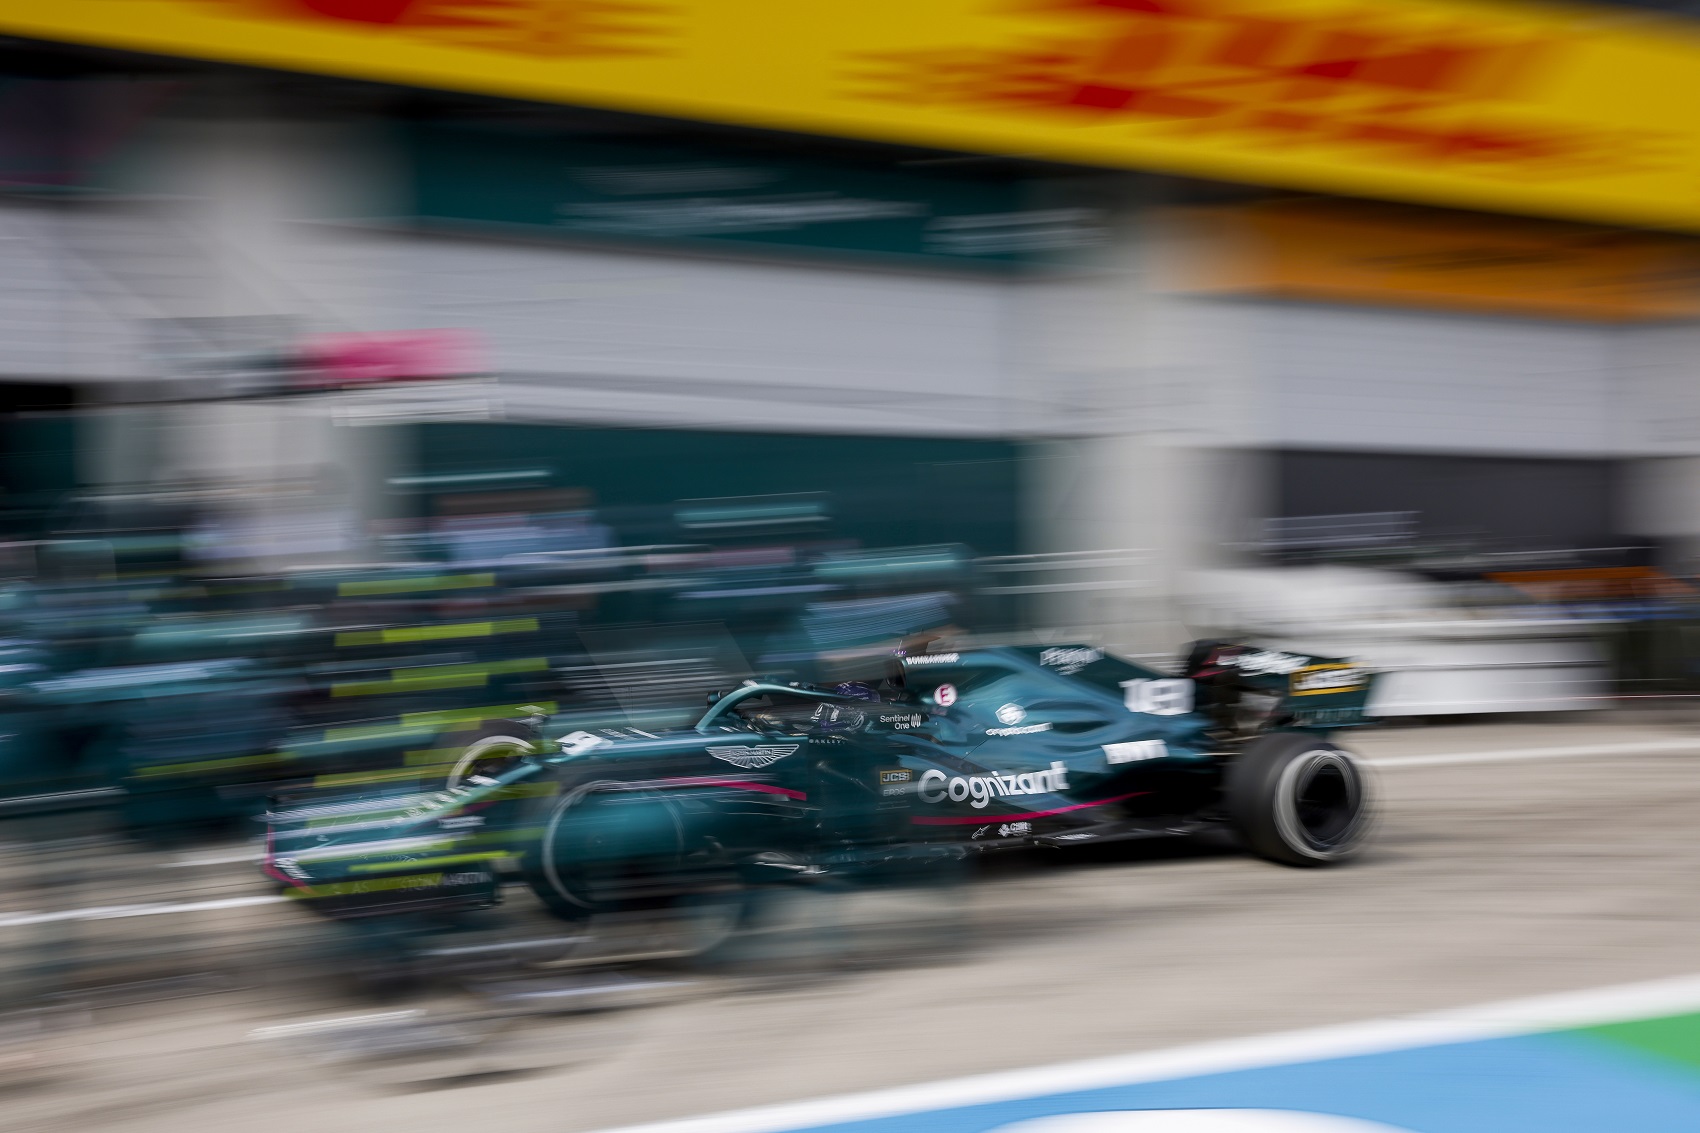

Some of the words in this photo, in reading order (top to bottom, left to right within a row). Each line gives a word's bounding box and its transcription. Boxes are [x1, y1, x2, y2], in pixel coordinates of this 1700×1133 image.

[880, 714, 910, 723] Sentinel
[894, 722, 910, 730] One
[882, 772, 910, 782] JCB
[917, 761, 1071, 809] Cognizant
